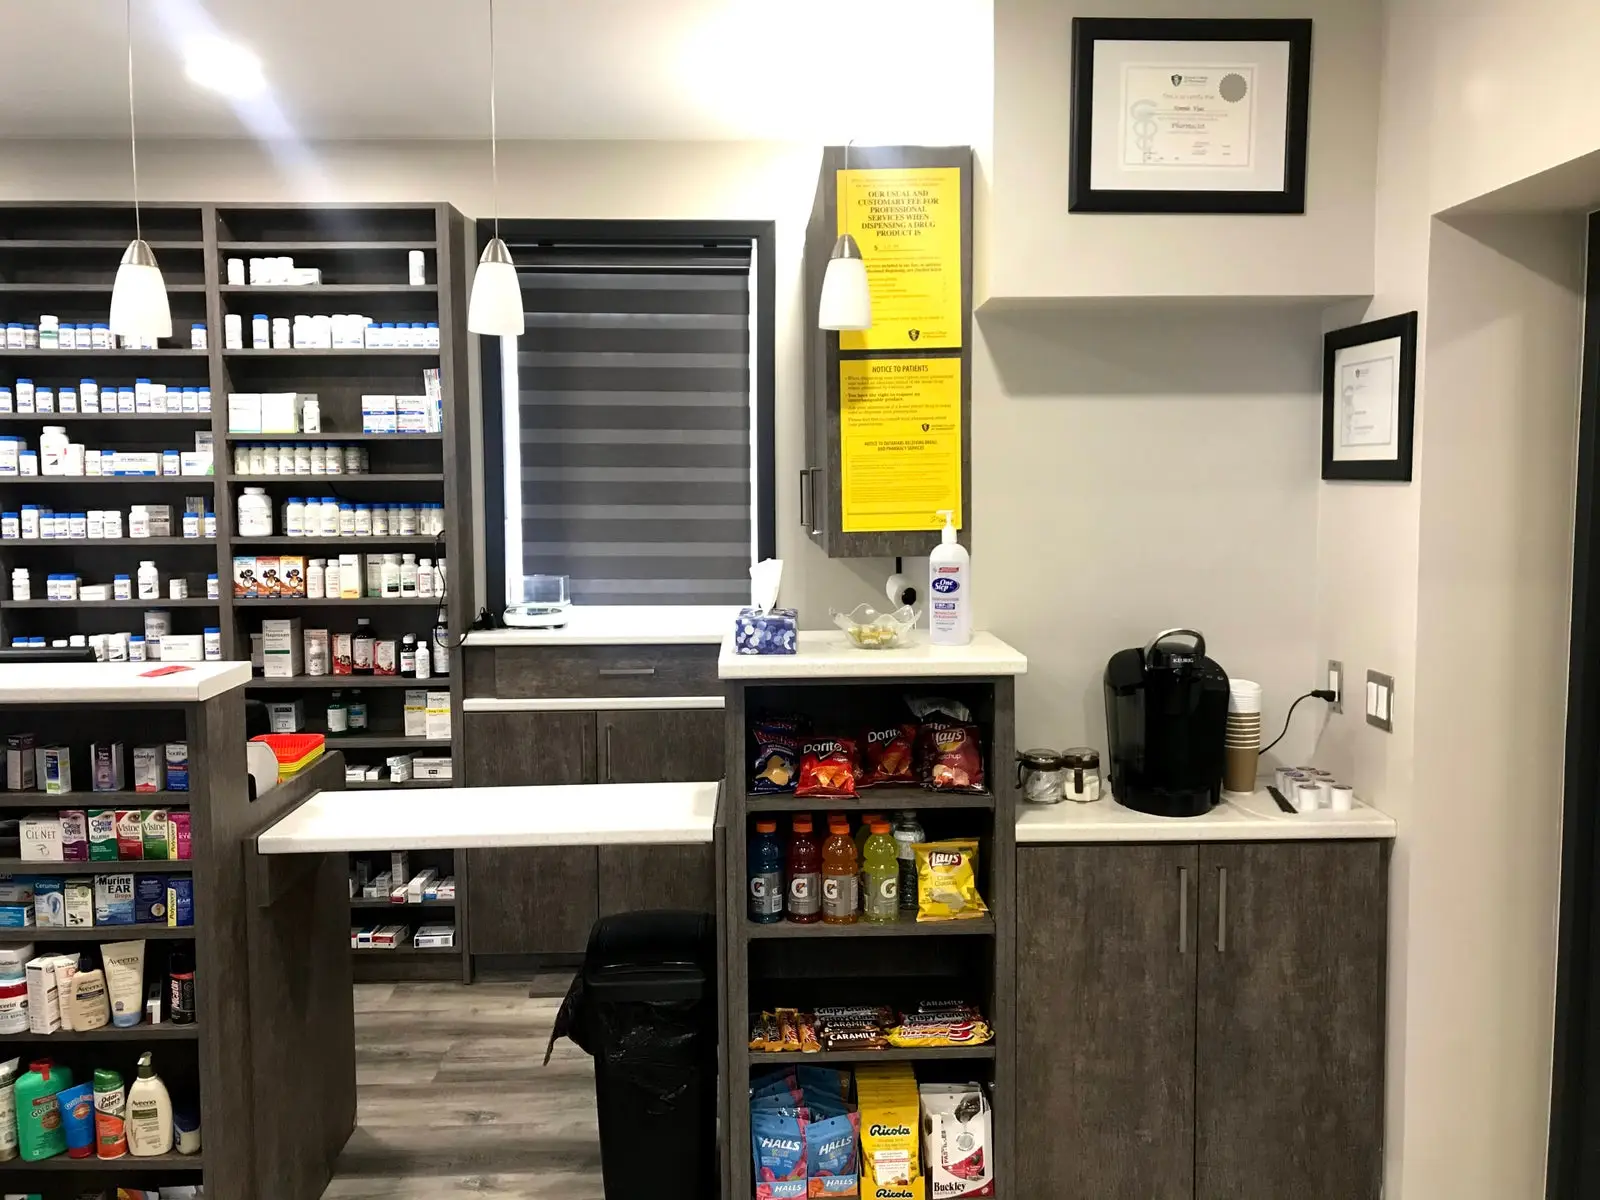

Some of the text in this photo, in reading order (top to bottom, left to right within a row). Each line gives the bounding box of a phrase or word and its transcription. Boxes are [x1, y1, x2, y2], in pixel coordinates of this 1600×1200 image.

[886, 190, 911, 198] USUAL
[872, 365, 892, 373] NOTICE
[902, 364, 929, 372] PATIENTS
[935, 583, 949, 591] Step
[867, 729, 902, 743] Dorit
[62, 821, 81, 831] Clear
[90, 819, 112, 829] Clear
[116, 823, 140, 832] Visine
[143, 822, 166, 832] Visine
[64, 827, 81, 835] eyes
[92, 825, 112, 834] eyes
[99, 876, 131, 886] Murine
[107, 885, 130, 893] EAR
[751, 877, 765, 897] G
[791, 878, 808, 898] G
[823, 879, 838, 899] G
[881, 878, 897, 898] G
[108, 957, 139, 966] Aveeno
[77, 984, 103, 993] Aveeno
[830, 1032, 876, 1041] CARAMILK
[132, 1099, 156, 1107] Aveeno
[31, 1104, 51, 1118] GOLD
[870, 1124, 911, 1137] Ricola
[762, 1137, 801, 1151] HALLS
[818, 1135, 853, 1156] HALLS
[826, 1178, 854, 1187] HALLS
[934, 1181, 967, 1193] Buckley
[775, 1184, 802, 1193] HALLS
[876, 1189, 914, 1199] Ricola
